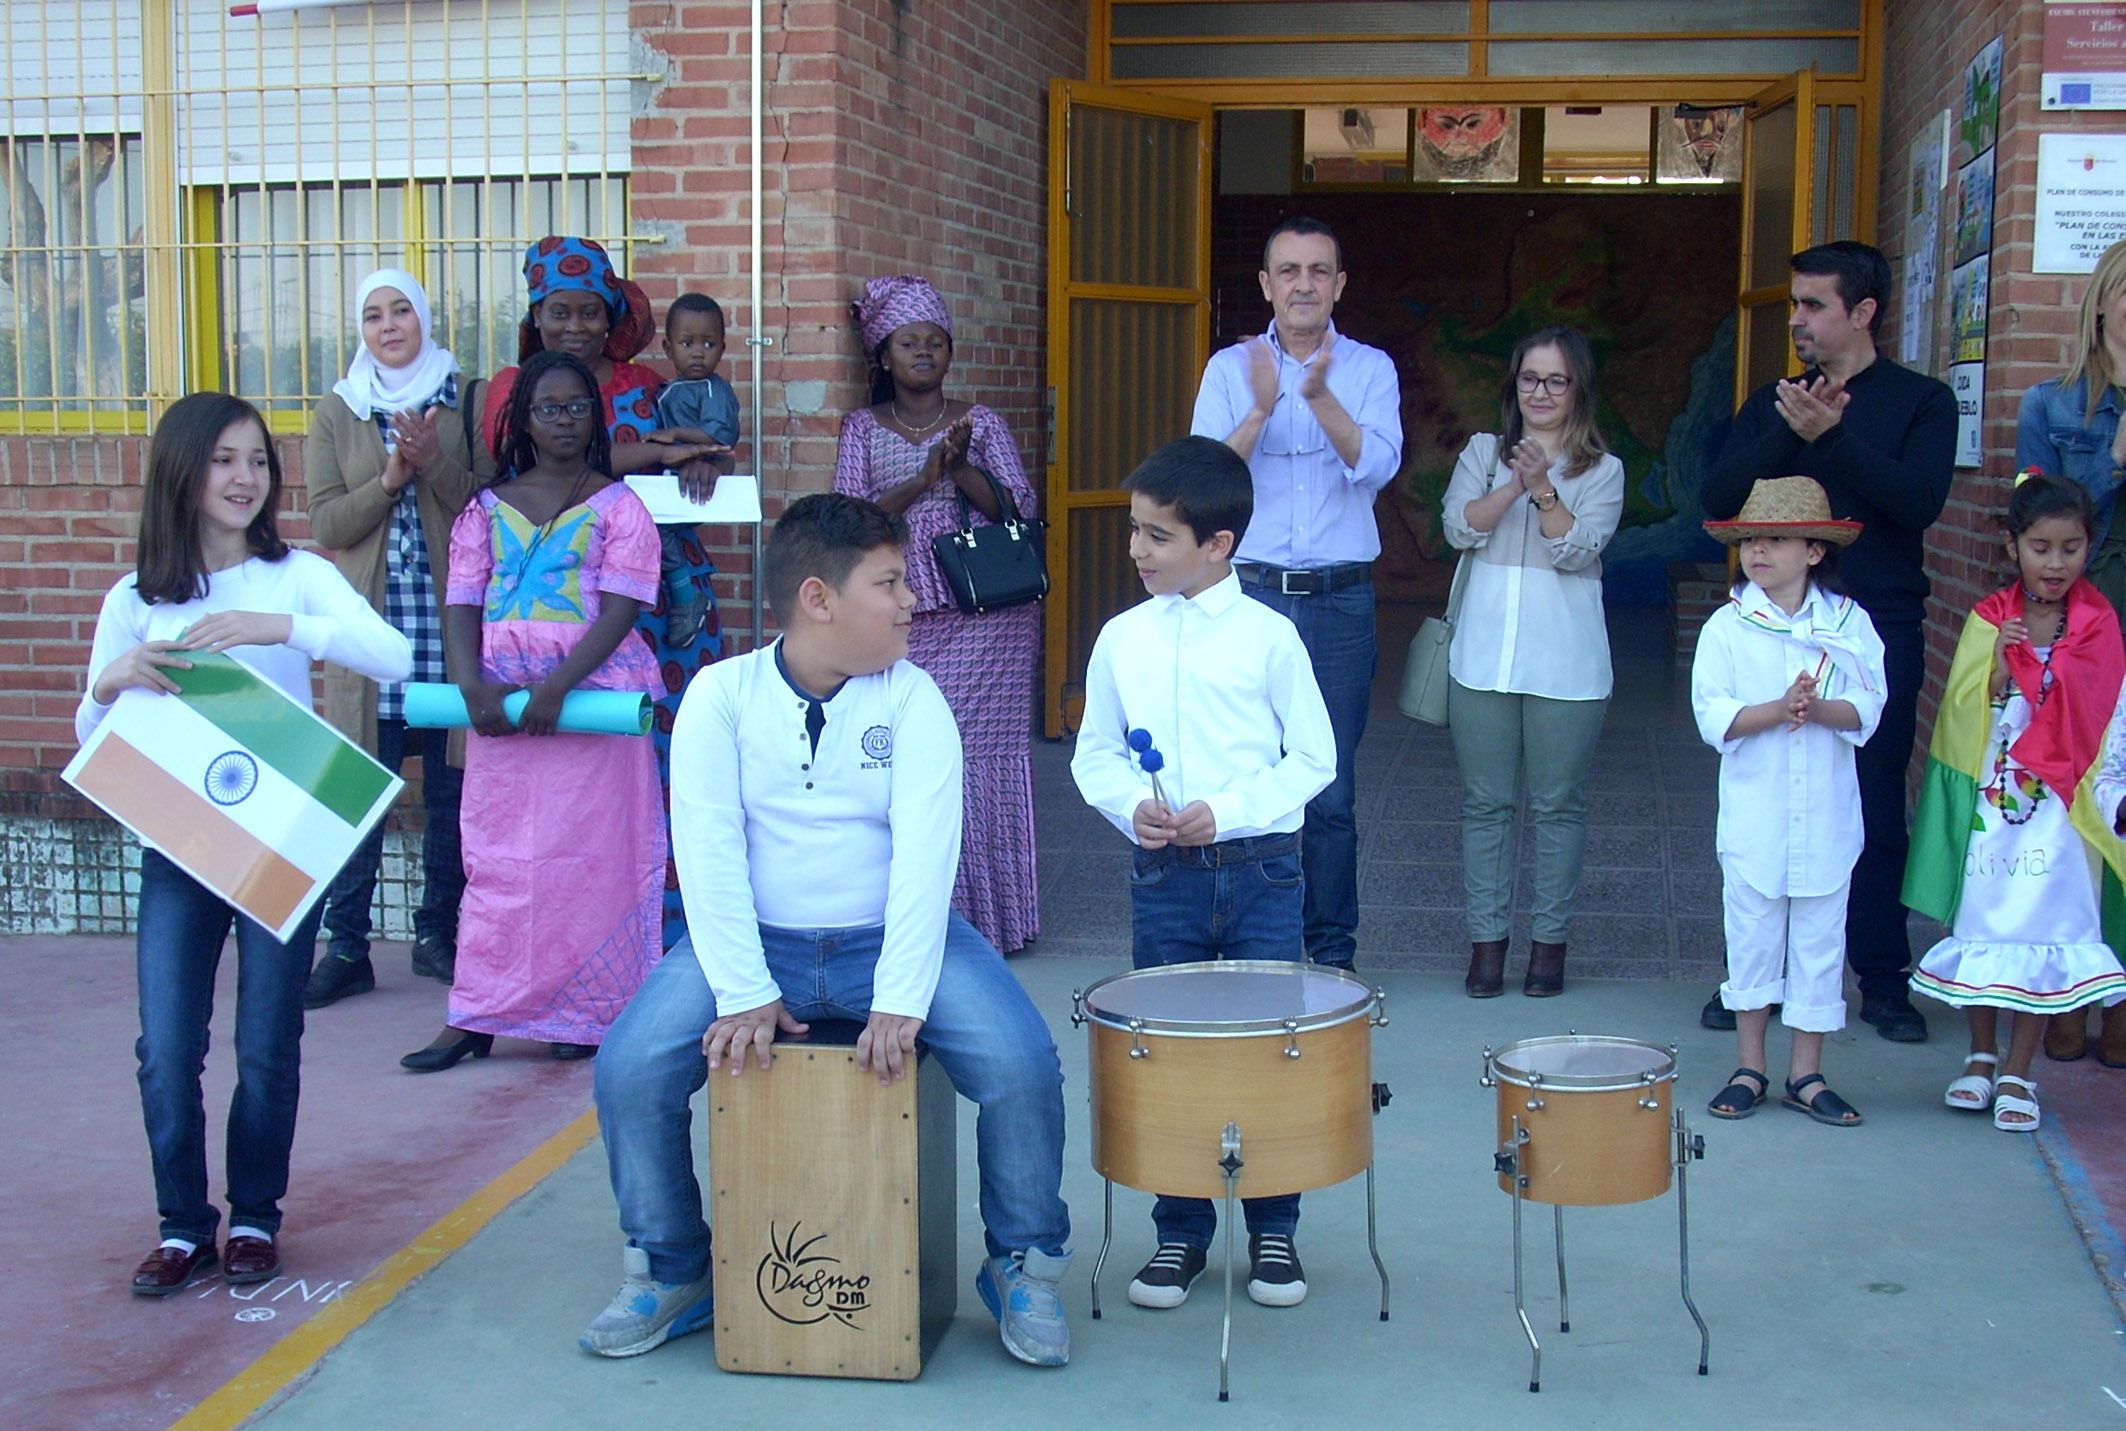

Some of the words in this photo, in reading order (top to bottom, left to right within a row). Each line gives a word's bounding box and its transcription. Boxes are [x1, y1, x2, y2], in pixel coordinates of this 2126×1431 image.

[2090, 20, 2123, 32] Taller
[2066, 37, 2117, 48] Servicios
[2046, 188, 2065, 196] PLAN
[2066, 188, 2076, 196] DE
[2078, 189, 2113, 197] CONSUMO
[2115, 189, 2125, 197] DE
[2087, 222, 2100, 230] DE
[836, 1291, 865, 1305] DM
